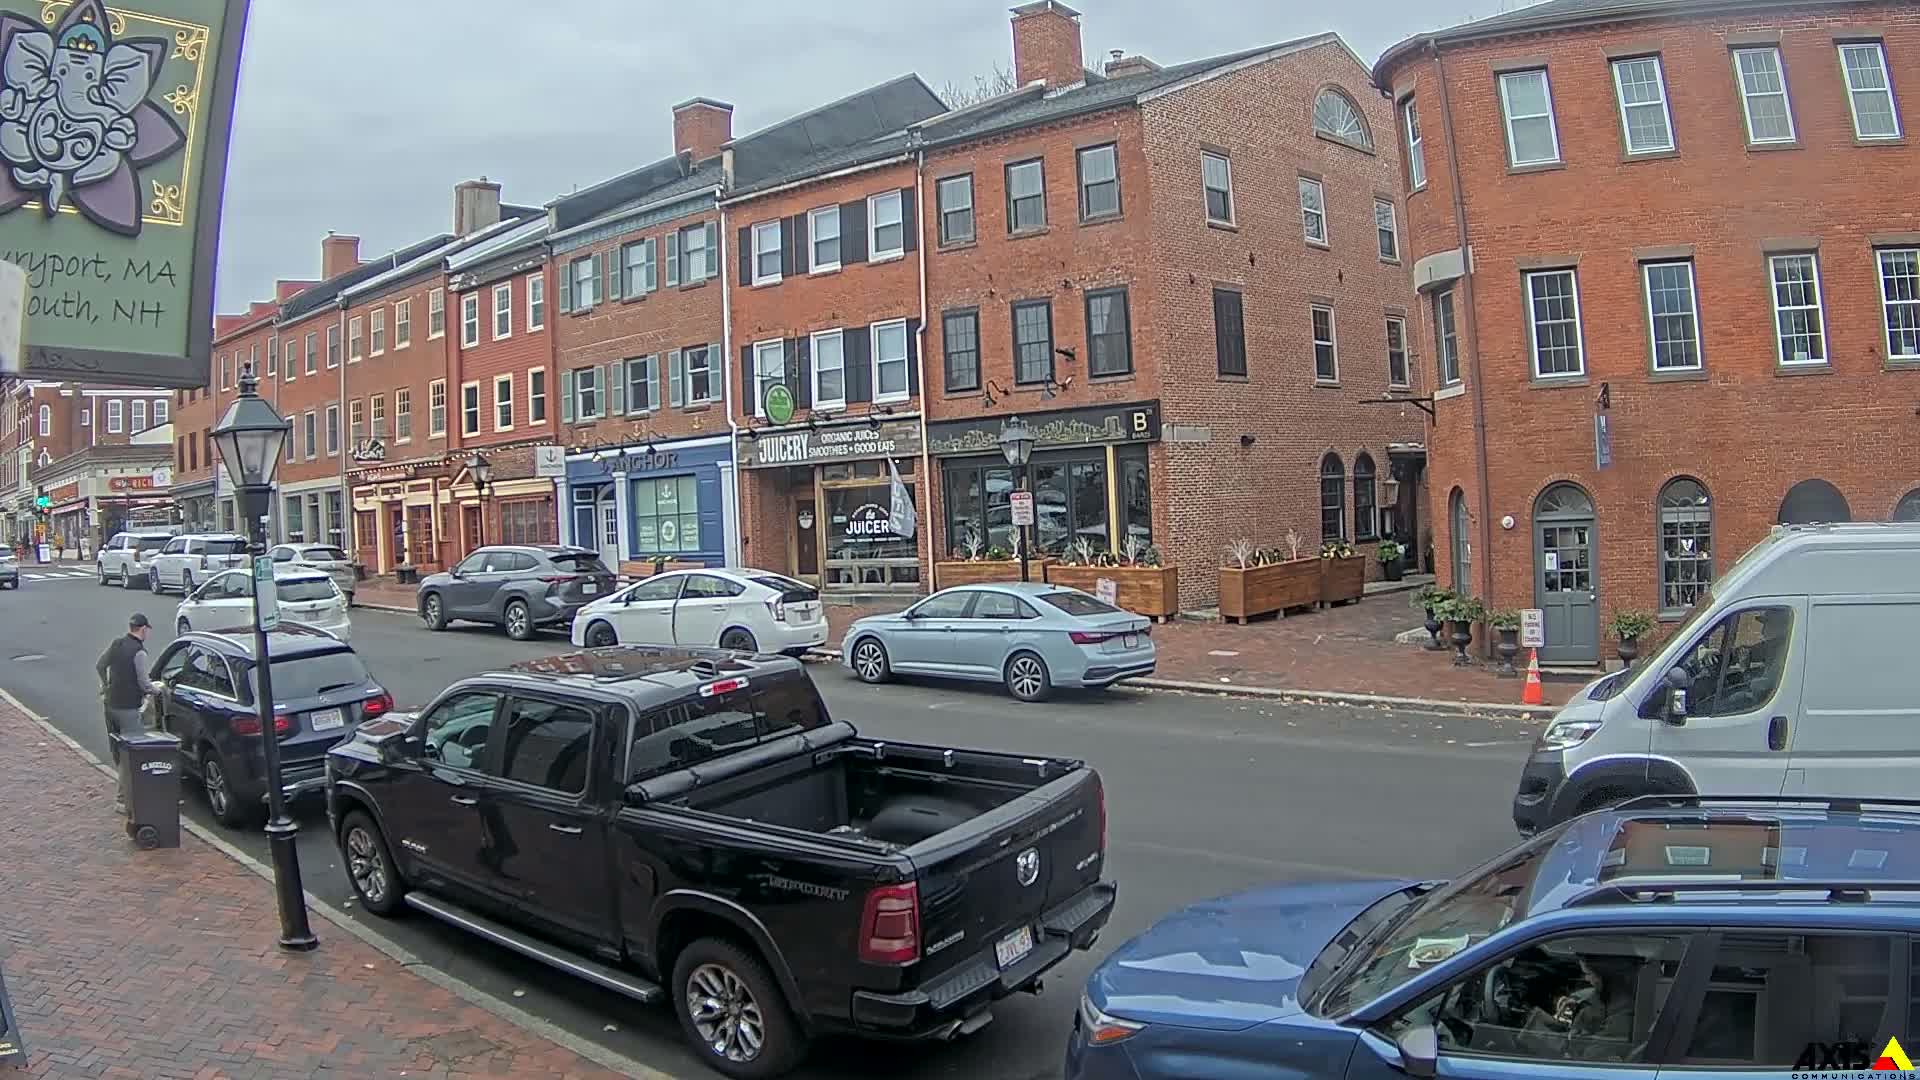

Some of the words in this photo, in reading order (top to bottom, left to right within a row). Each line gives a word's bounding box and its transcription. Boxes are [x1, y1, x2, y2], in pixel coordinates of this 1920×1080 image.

[123, 257, 177, 288] MA
[112, 298, 167, 328] NH
[1133, 412, 1147, 431] B
[821, 431, 852, 443] ORGANIC
[853, 429, 880, 441] JUICES
[758, 433, 809, 463] JUICERY
[808, 444, 848, 457] SMOOTHIES
[854, 442, 877, 454] GOOD
[877, 440, 896, 452] EATS
[612, 452, 680, 474] ANCHOR
